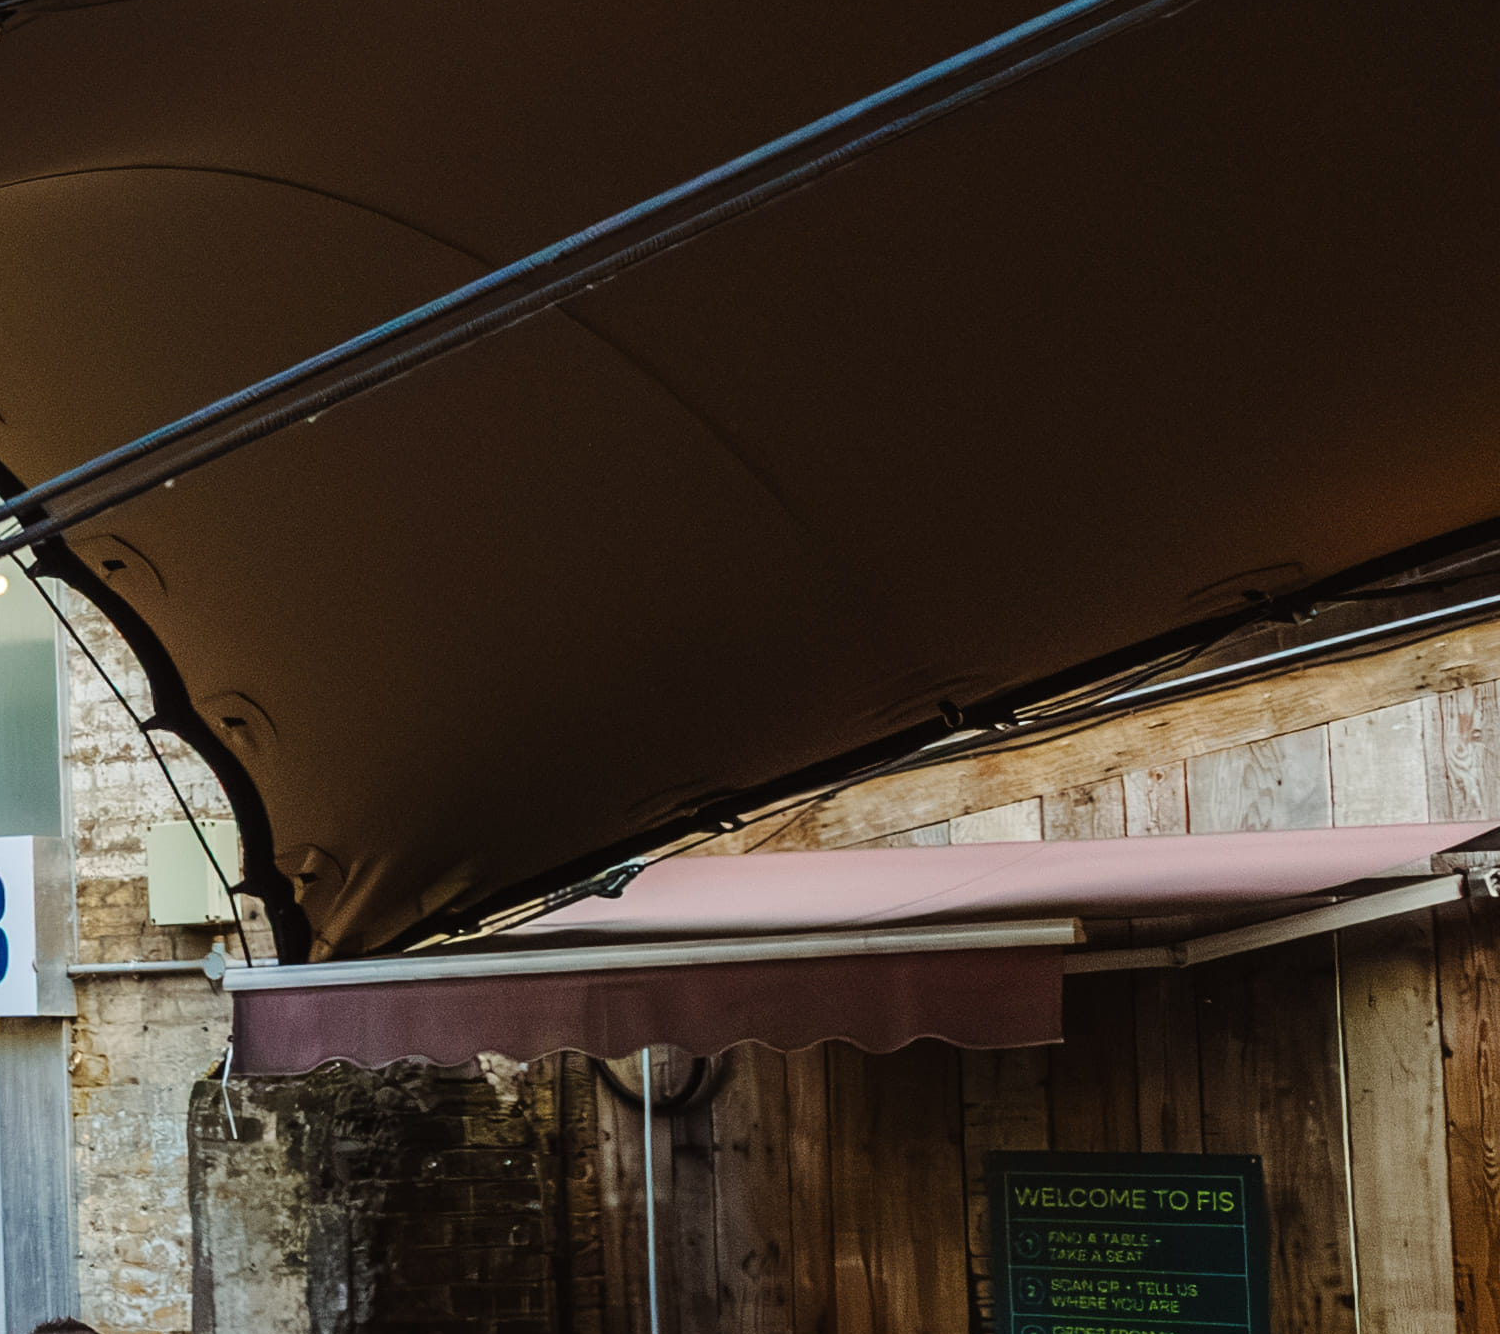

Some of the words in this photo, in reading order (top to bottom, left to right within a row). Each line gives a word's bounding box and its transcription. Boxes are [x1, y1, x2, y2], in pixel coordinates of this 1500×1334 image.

[1015, 1186, 1148, 1210] WELCOME
[1153, 1189, 1190, 1212] TO
[1197, 1190, 1236, 1213] FIS
[1102, 1233, 1150, 1247] TABLE
[1089, 1250, 1101, 1262] A
[1107, 1250, 1144, 1263] SEAT
[1051, 1278, 1094, 1293] SCAN
[1137, 1281, 1174, 1297] TELL
[1177, 1284, 1199, 1297] US
[1051, 1296, 1108, 1310] WHERE
[1111, 1298, 1145, 1312] YOU
[1149, 1300, 1182, 1314] ARE
